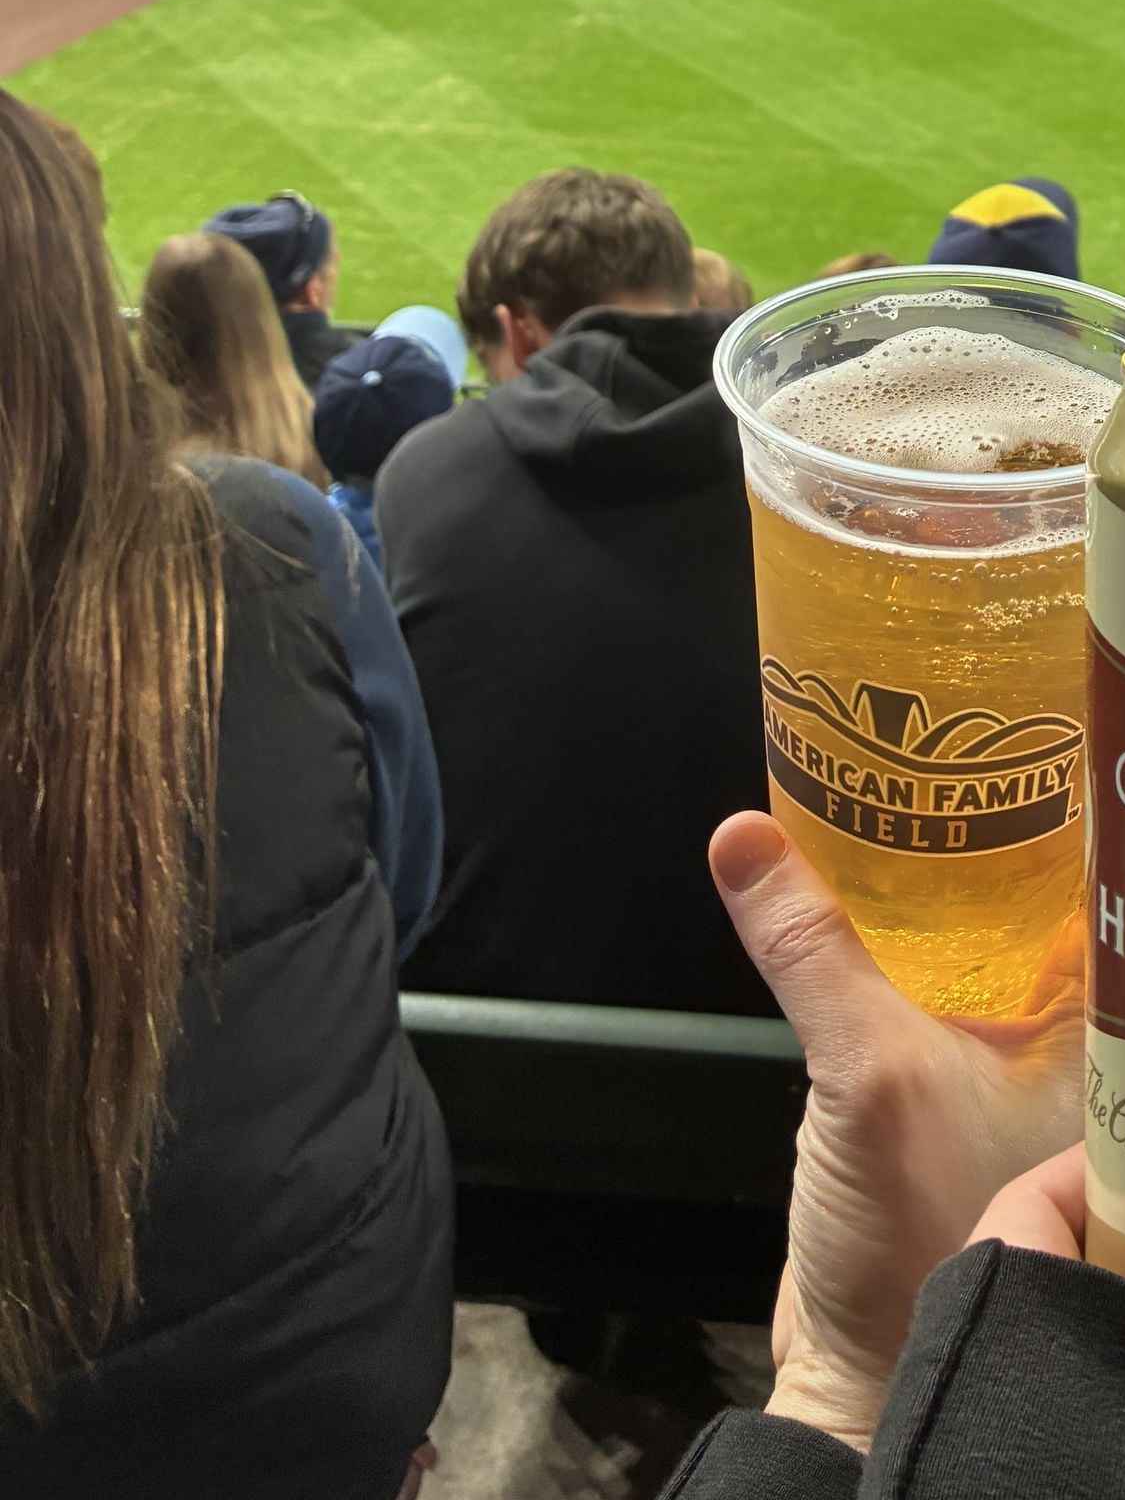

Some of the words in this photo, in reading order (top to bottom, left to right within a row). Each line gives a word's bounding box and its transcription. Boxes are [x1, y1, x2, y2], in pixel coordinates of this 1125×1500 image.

[763, 695, 916, 811] AMERICAN
[931, 752, 1079, 813] FAMILY
[825, 790, 968, 848] FIELD
[1086, 1051, 1107, 1128] The
